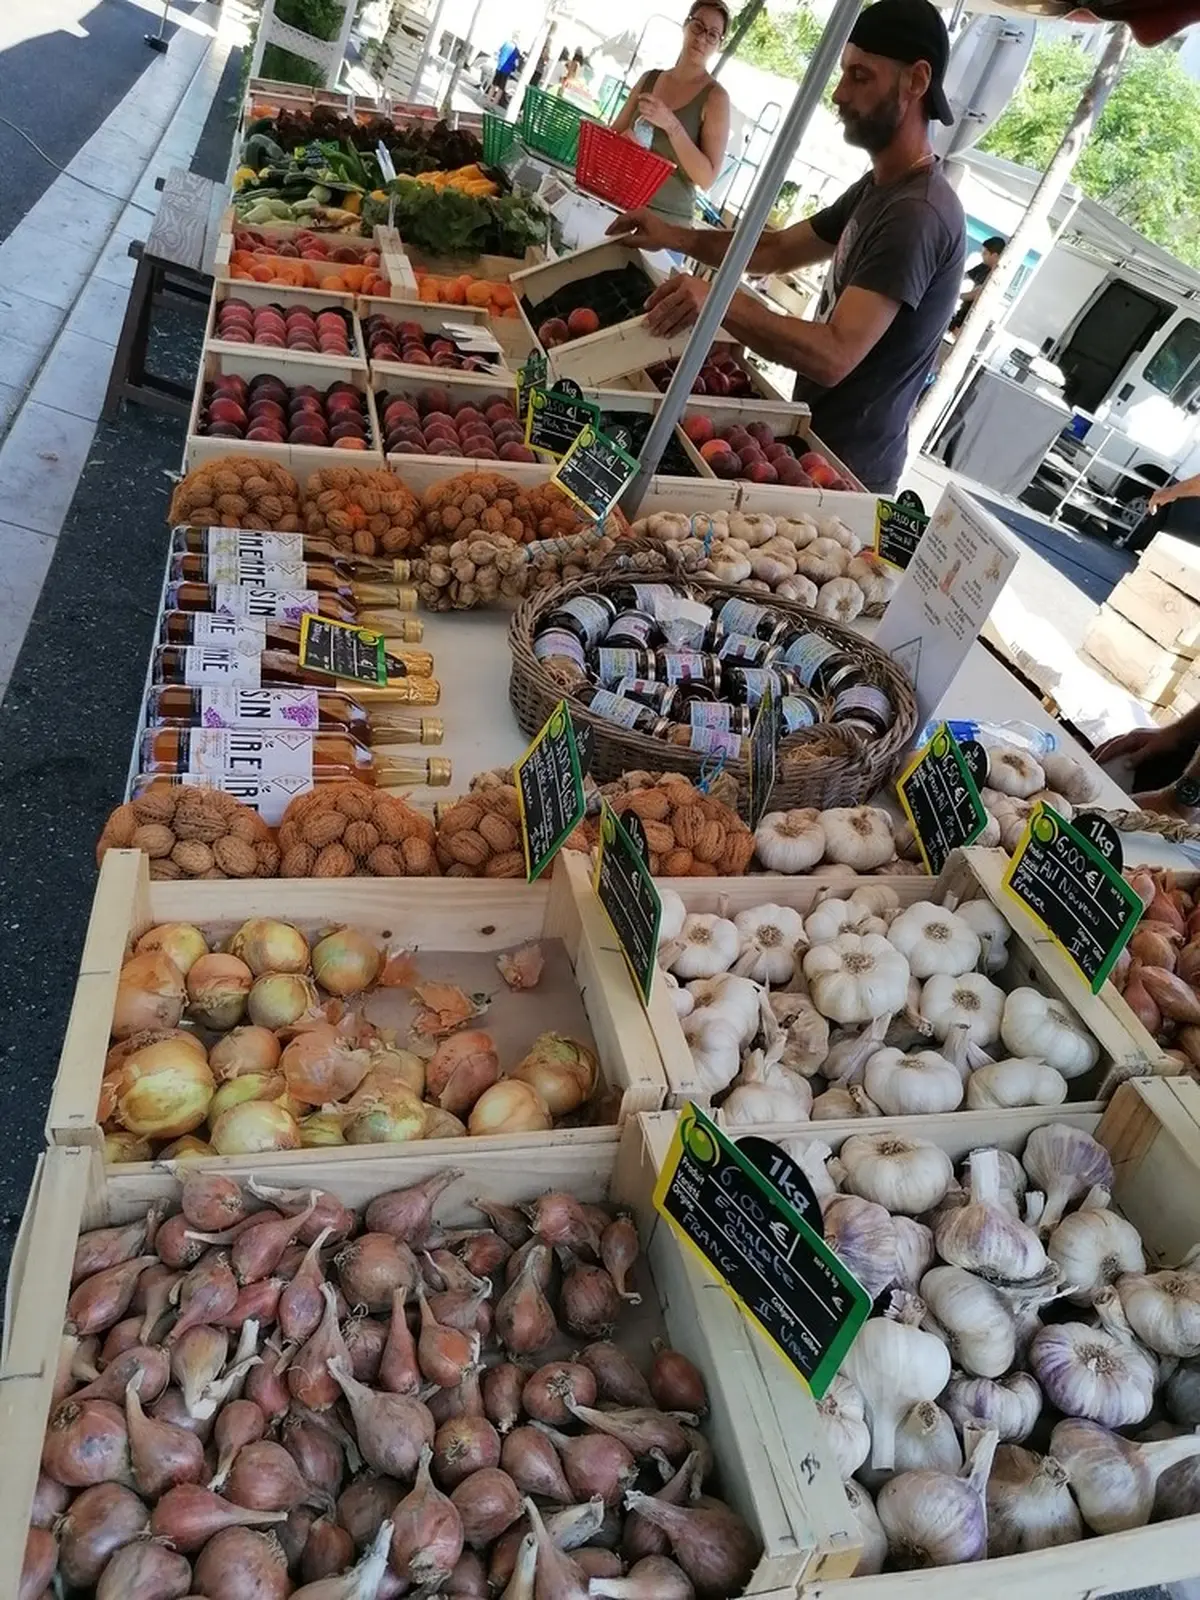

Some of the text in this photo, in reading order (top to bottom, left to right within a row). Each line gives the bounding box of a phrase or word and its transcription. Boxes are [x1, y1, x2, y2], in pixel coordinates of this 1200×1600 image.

[561, 382, 576, 398] 1kg
[942, 755, 960, 787] 6,50
[1090, 820, 1114, 857] 1kg
[1039, 861, 1058, 881] Ail
[1056, 836, 1099, 890] 6,00 €
[676, 1169, 700, 1200] Variété
[681, 1158, 705, 1186] Produit
[768, 1155, 811, 1215] 1kg
[672, 1184, 695, 1212] Origine
[720, 1166, 790, 1250] 6,00 €
[682, 1212, 738, 1272] FRANCE
[714, 1196, 794, 1290] Echalote
[832, 1295, 842, 1312] €
[800, 1332, 820, 1356] Calibre
